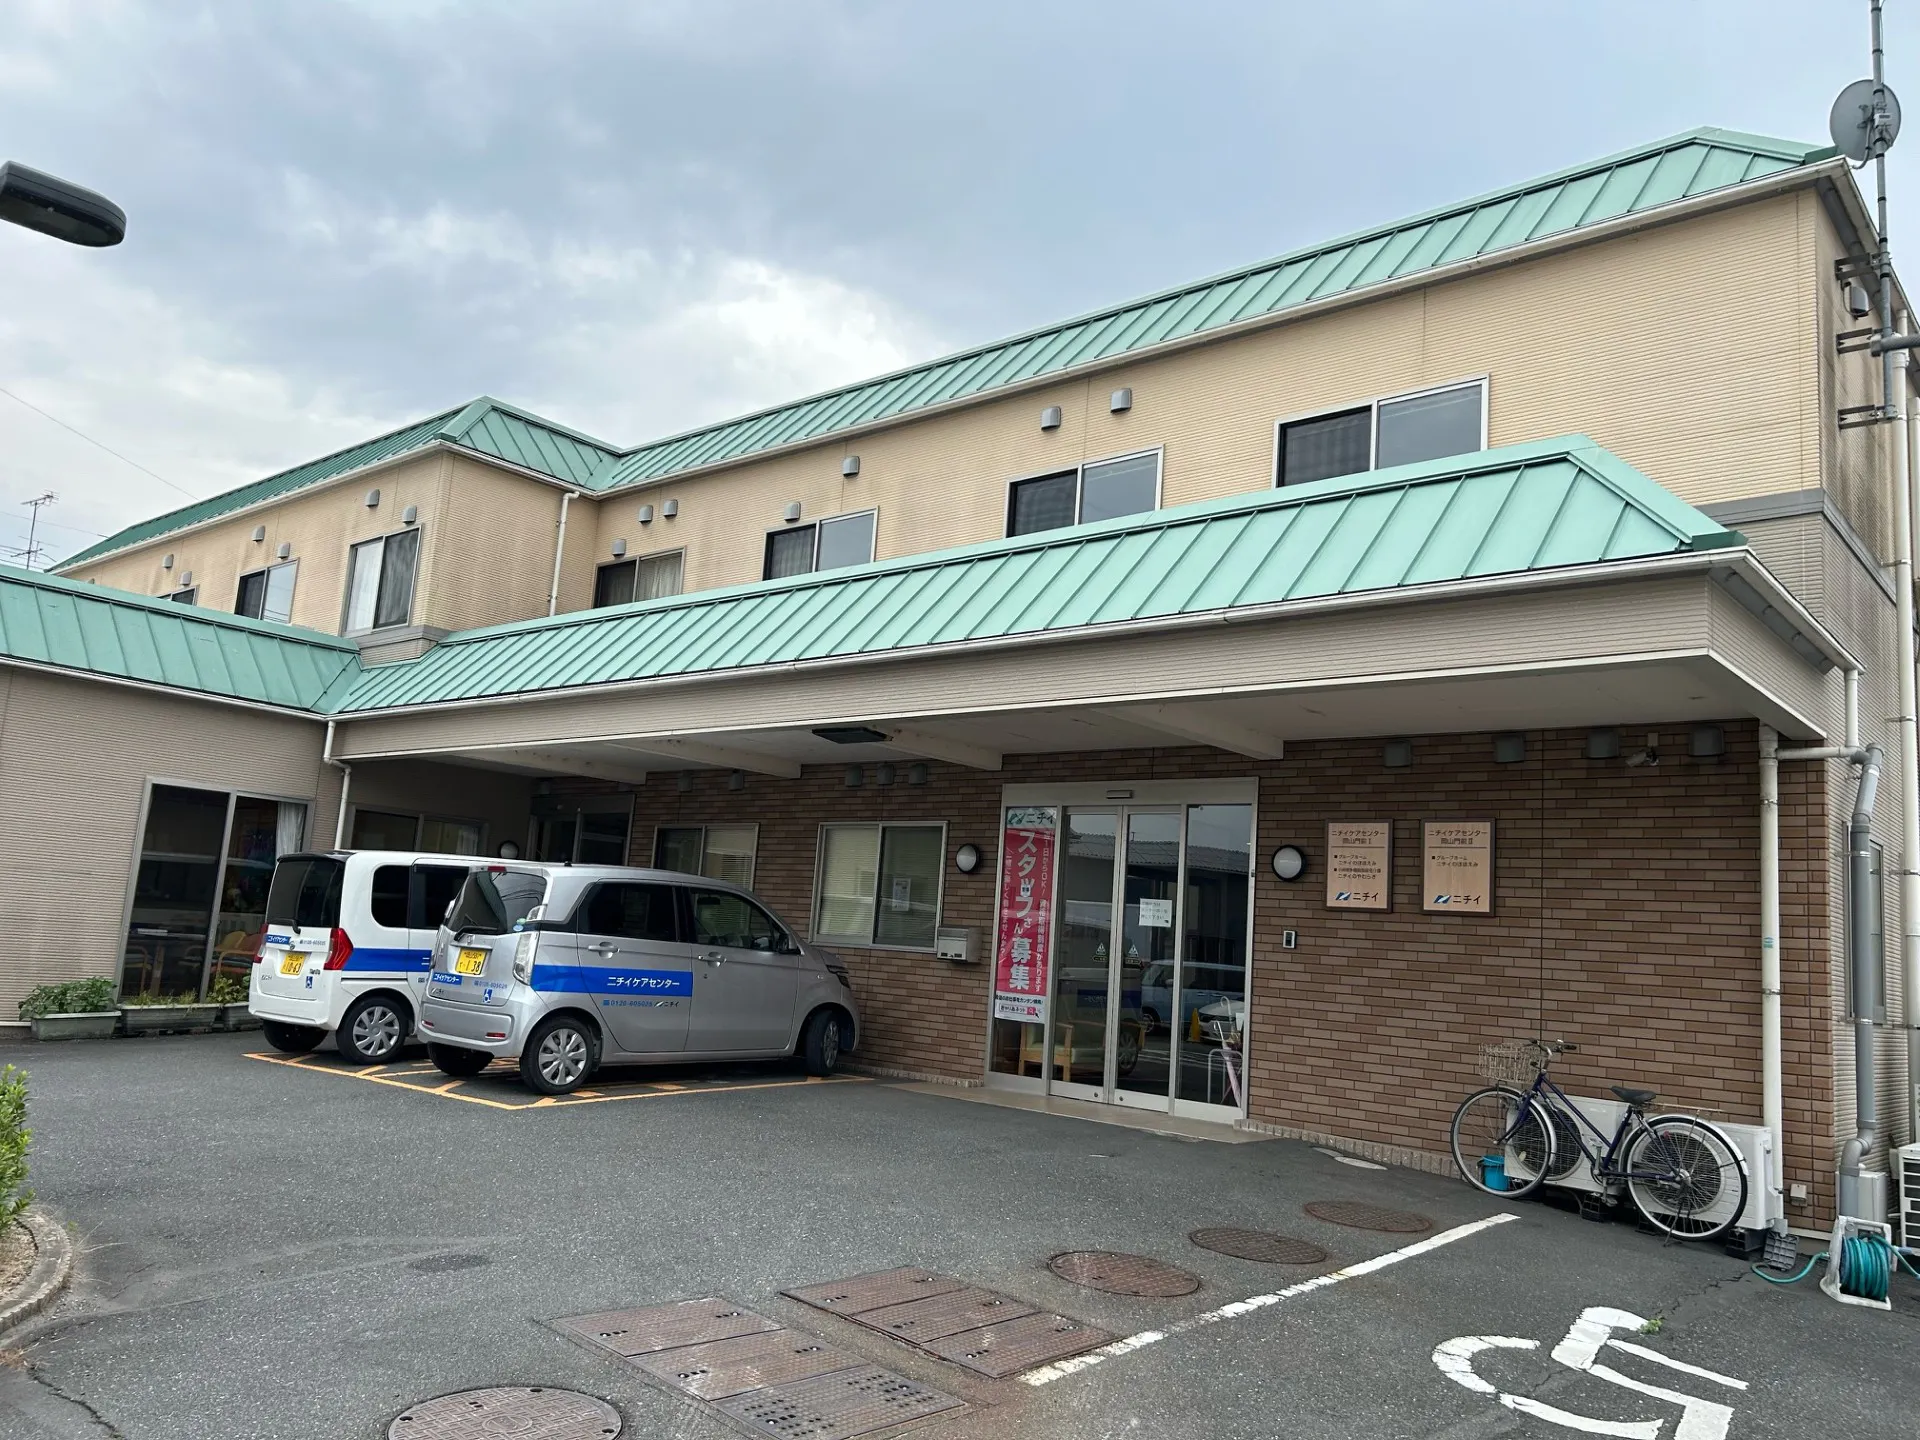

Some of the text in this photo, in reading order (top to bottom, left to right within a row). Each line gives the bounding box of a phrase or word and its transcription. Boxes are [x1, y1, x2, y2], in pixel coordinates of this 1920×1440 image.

[1025, 812, 1054, 825] ニチイ
[1428, 829, 1488, 837] ニチイケアセンター
[1352, 892, 1379, 902] ニチイ
[1452, 895, 1481, 905] ニチイ
[1009, 831, 1038, 990] スタッフさん募集
[433, 973, 460, 983] ニチイケアセンター
[607, 976, 680, 988] ニチイケアセンター
